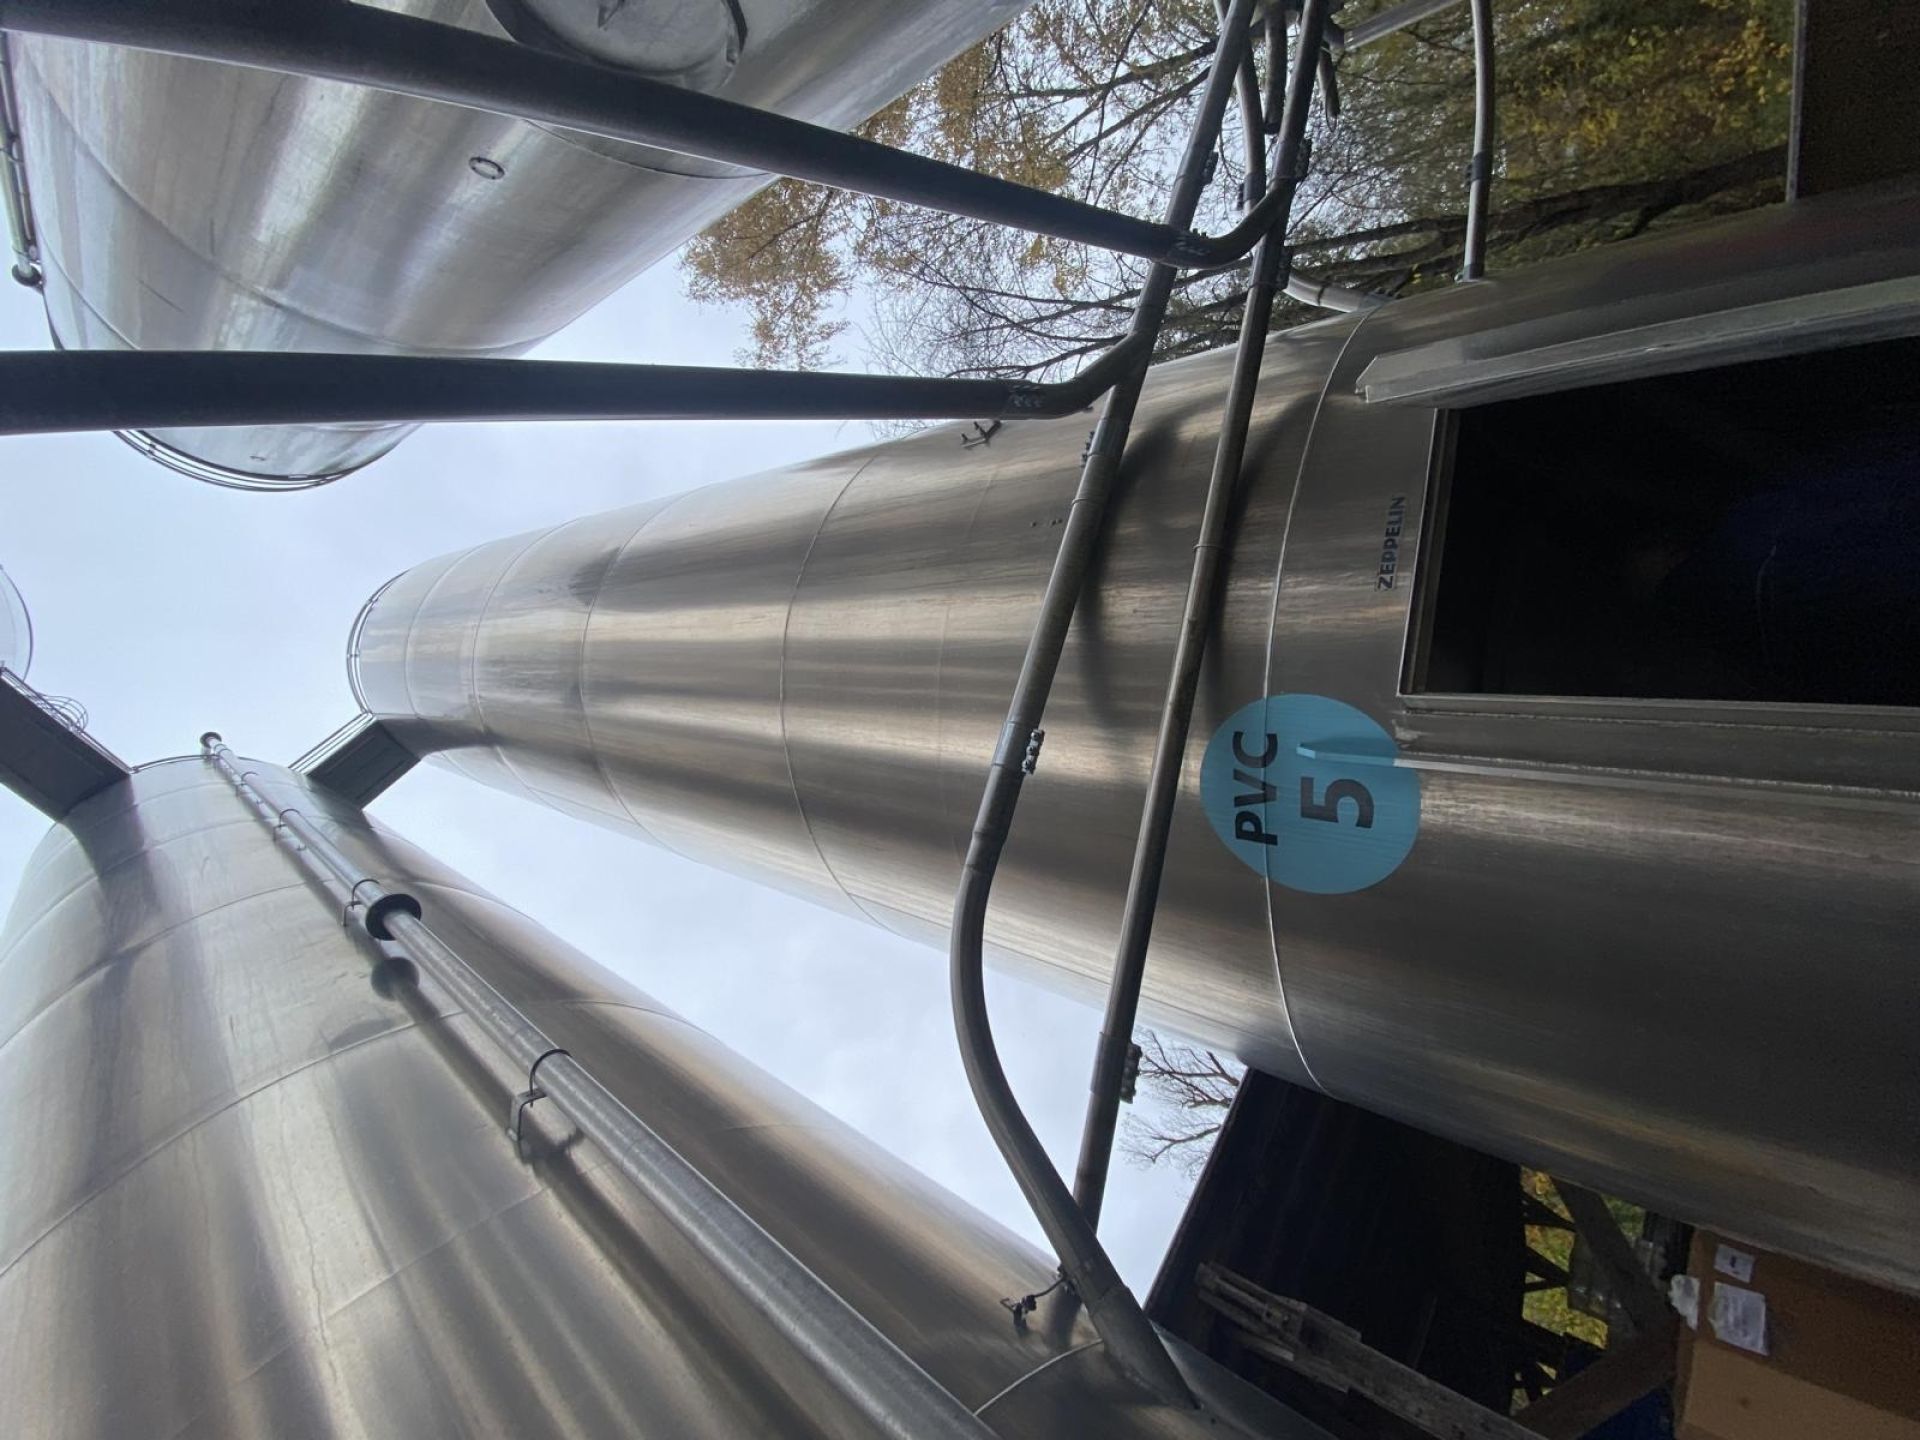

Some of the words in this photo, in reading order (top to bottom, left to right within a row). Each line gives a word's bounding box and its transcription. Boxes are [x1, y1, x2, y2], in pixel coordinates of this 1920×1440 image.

[1377, 496, 1406, 591] ZEPPELIN
[1232, 730, 1278, 846] PVC
[1300, 776, 1375, 830] 5
